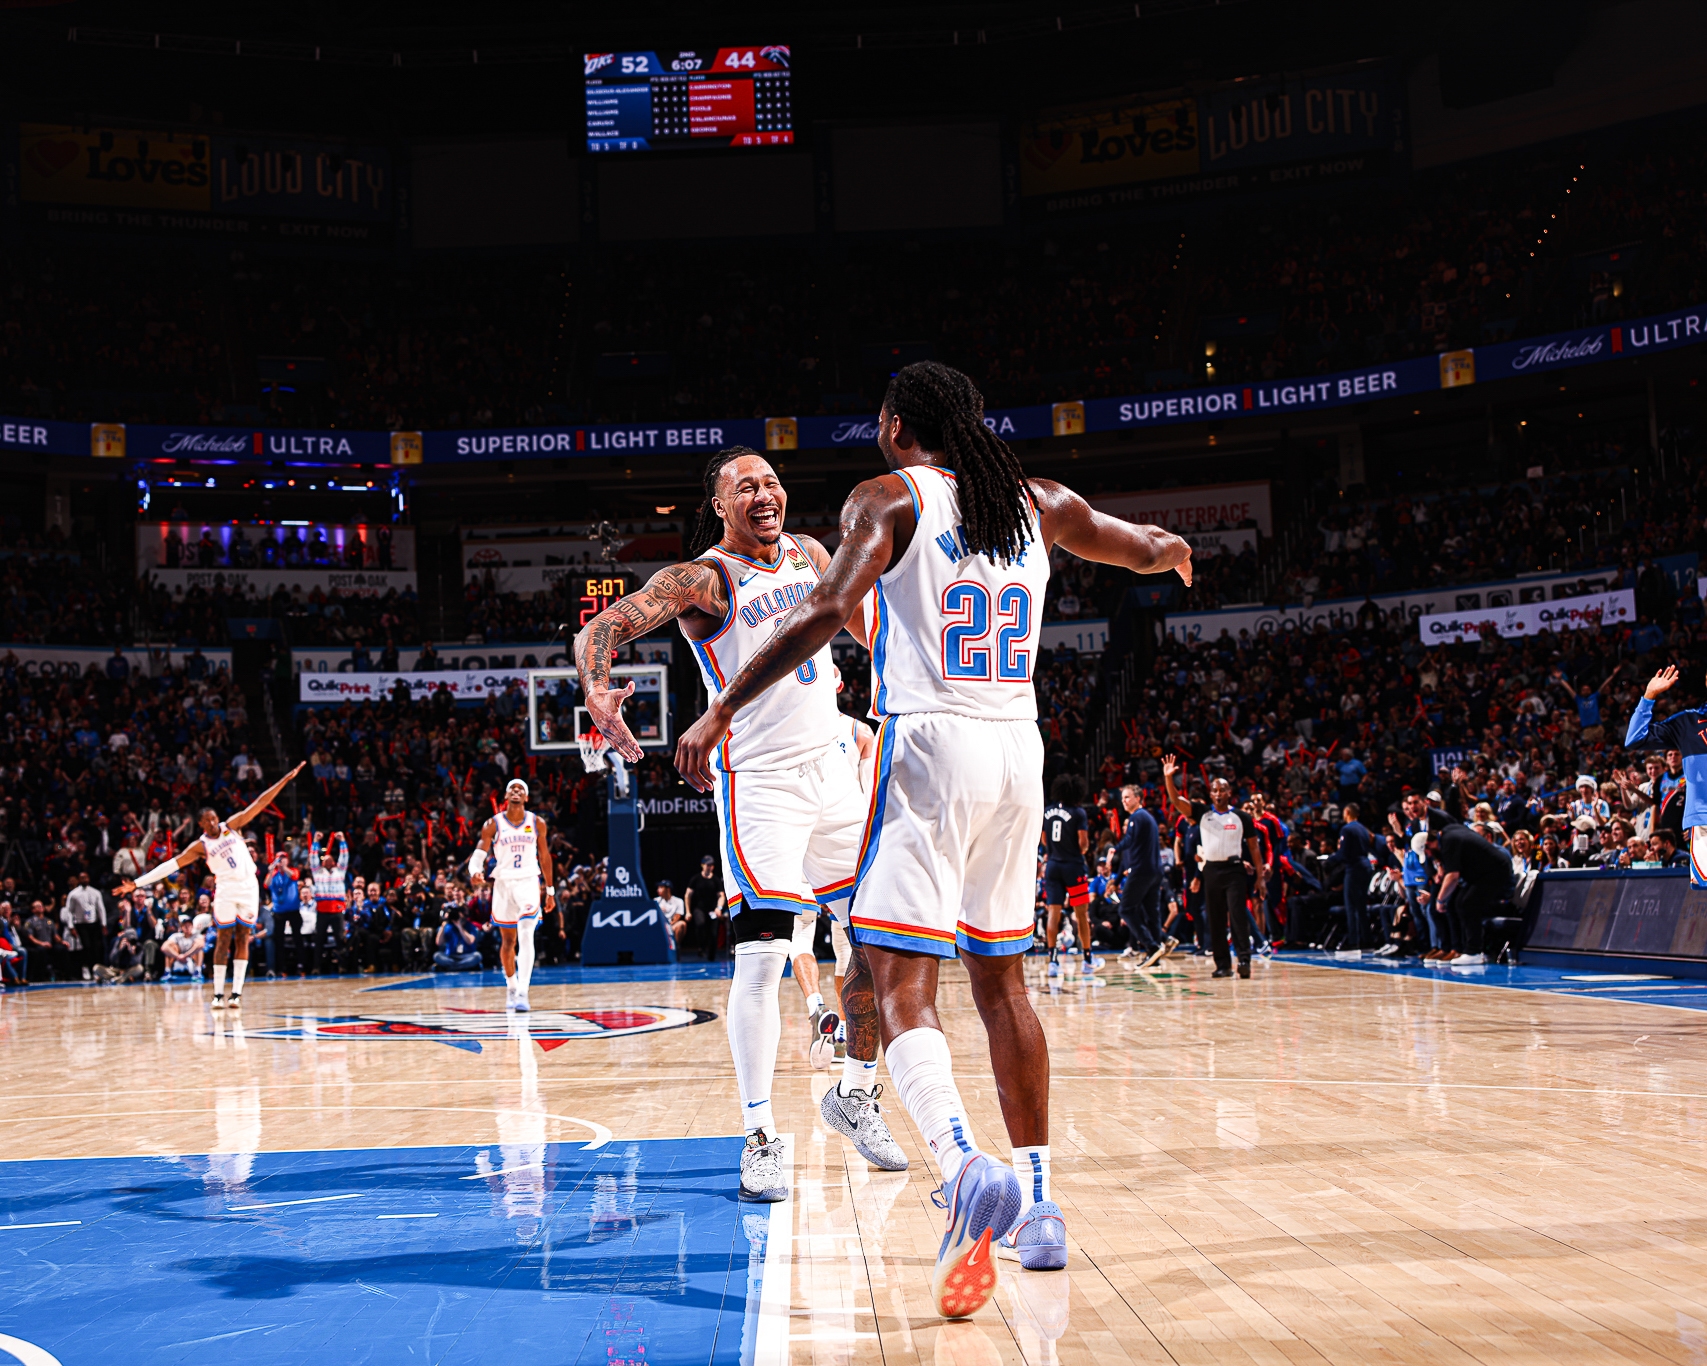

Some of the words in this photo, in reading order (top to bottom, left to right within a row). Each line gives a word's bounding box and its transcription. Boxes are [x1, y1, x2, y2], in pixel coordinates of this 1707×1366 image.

[622, 56, 649, 73] 52
[671, 59, 703, 71] 6:07
[725, 51, 755, 69] 44
[1207, 94, 1293, 162] LOUD
[1304, 88, 1379, 138] CITY
[220, 151, 303, 203] LOUD
[315, 152, 384, 210] CITY
[1046, 194, 1104, 212] BRING
[1108, 188, 1146, 204] THE
[1151, 175, 1240, 198] THUNDER
[1269, 164, 1313, 182] EXIT
[1319, 158, 1366, 177] NOW
[47, 209, 109, 224] BRING
[114, 213, 153, 227] THE
[157, 215, 250, 233] THUNDER
[279, 222, 321, 237] EXIT
[326, 226, 369, 239] NOW
[1511, 334, 1605, 370] Michelob
[1119, 393, 1238, 421] SUPERIOR
[1258, 382, 1331, 407] LIGHT
[1338, 371, 1398, 398] BEER
[0, 424, 48, 446] EER
[457, 433, 571, 454] SUPERIOR
[590, 430, 659, 449] LIGHT
[665, 428, 724, 446] BEER
[831, 421, 880, 443] Mich
[162, 433, 248, 453] Michelob
[270, 436, 353, 455] ULTRA
[1174, 502, 1250, 526] TERRACE
[1201, 536, 1221, 549] OAK
[187, 572, 213, 585] POST
[227, 573, 248, 585] OAK
[328, 574, 354, 587] POST
[367, 575, 389, 587] OAK
[586, 579, 624, 596] 6:07
[740, 582, 815, 628] OKLAHO
[941, 580, 1032, 683] 22
[307, 679, 371, 694] QuikPrint
[1052, 820, 1063, 842] 8
[501, 836, 535, 846] OKLAHOMA
[220, 847, 233, 859] CITY
[226, 856, 237, 869] 8
[513, 854, 522, 869] 2
[605, 884, 643, 898] Health
[1628, 900, 1661, 916] ULTRA
[592, 909, 658, 928] KIA
